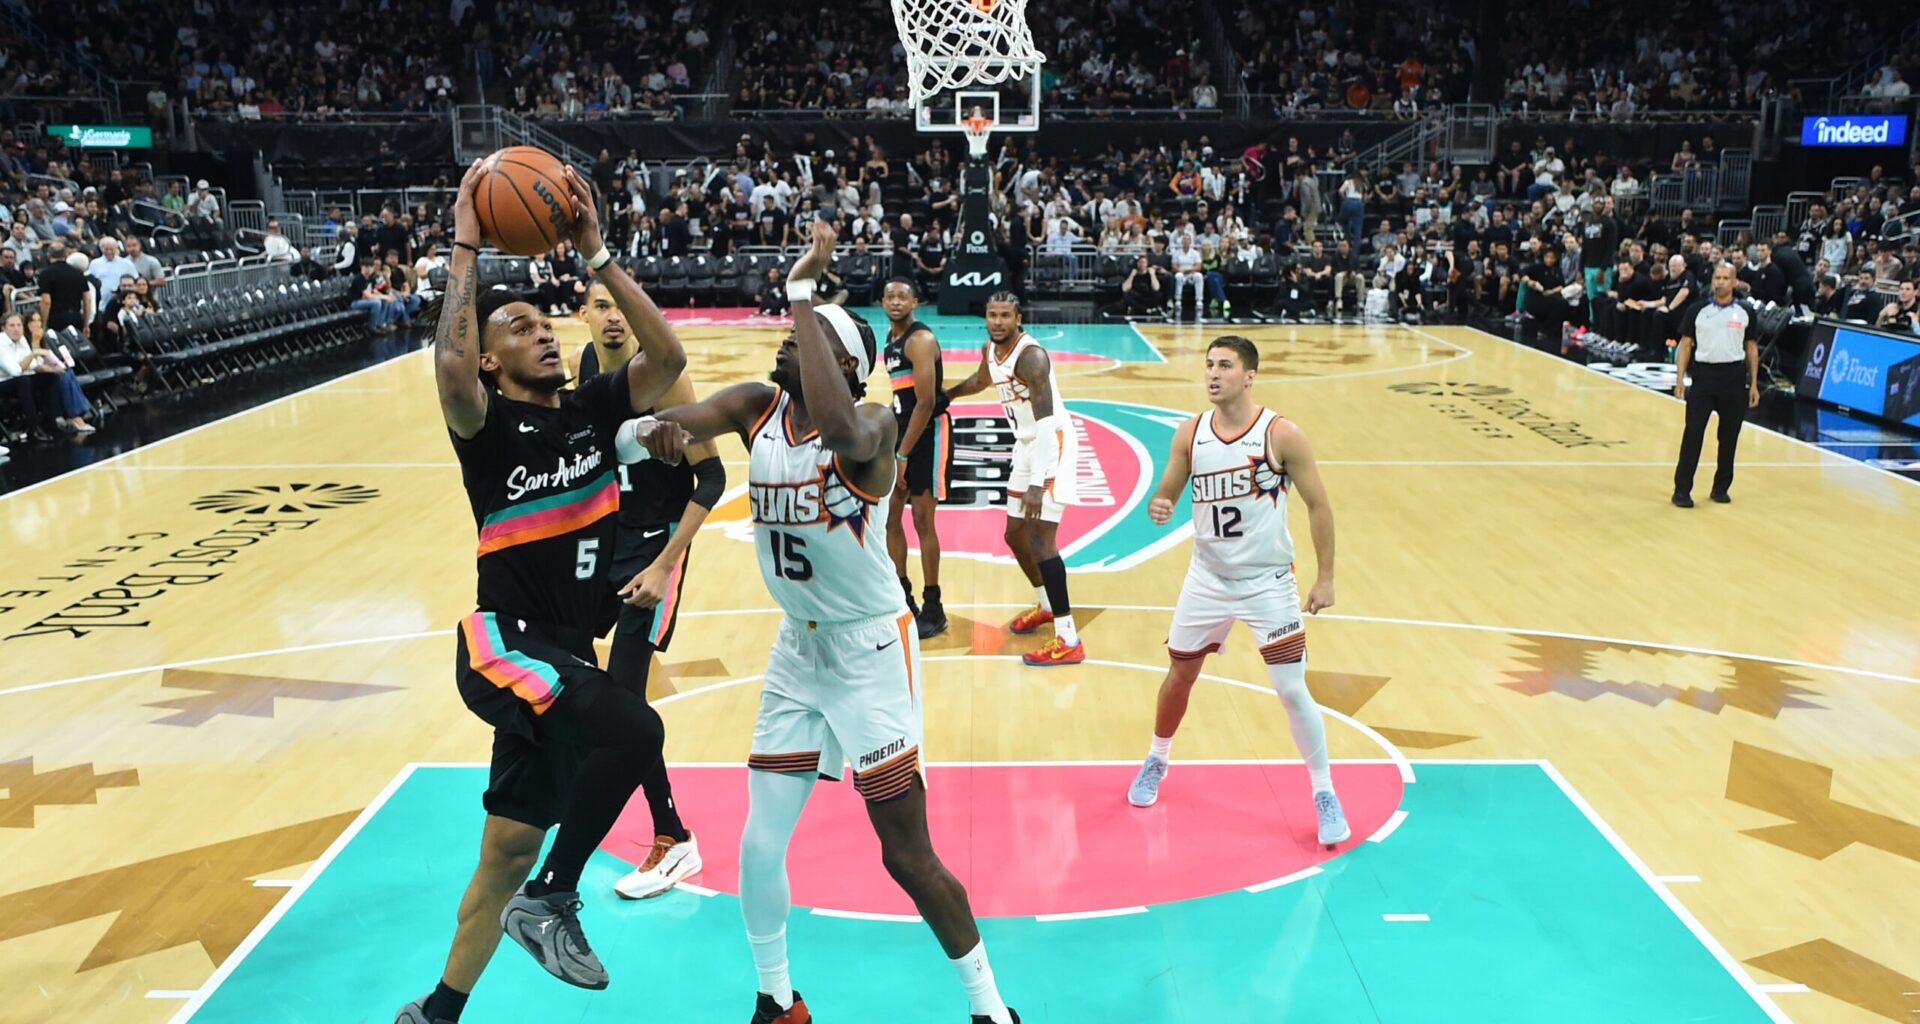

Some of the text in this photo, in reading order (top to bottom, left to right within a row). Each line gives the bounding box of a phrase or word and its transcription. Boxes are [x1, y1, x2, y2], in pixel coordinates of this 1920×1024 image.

[1818, 120, 1889, 143] indeed
[1845, 358, 1878, 388] Frost
[507, 445, 602, 500] San Antonio
[1191, 468, 1252, 503] SUNS
[1212, 504, 1244, 538] 12
[575, 537, 600, 580] 5
[769, 529, 813, 581] 15
[859, 736, 907, 768] PHOENIX
